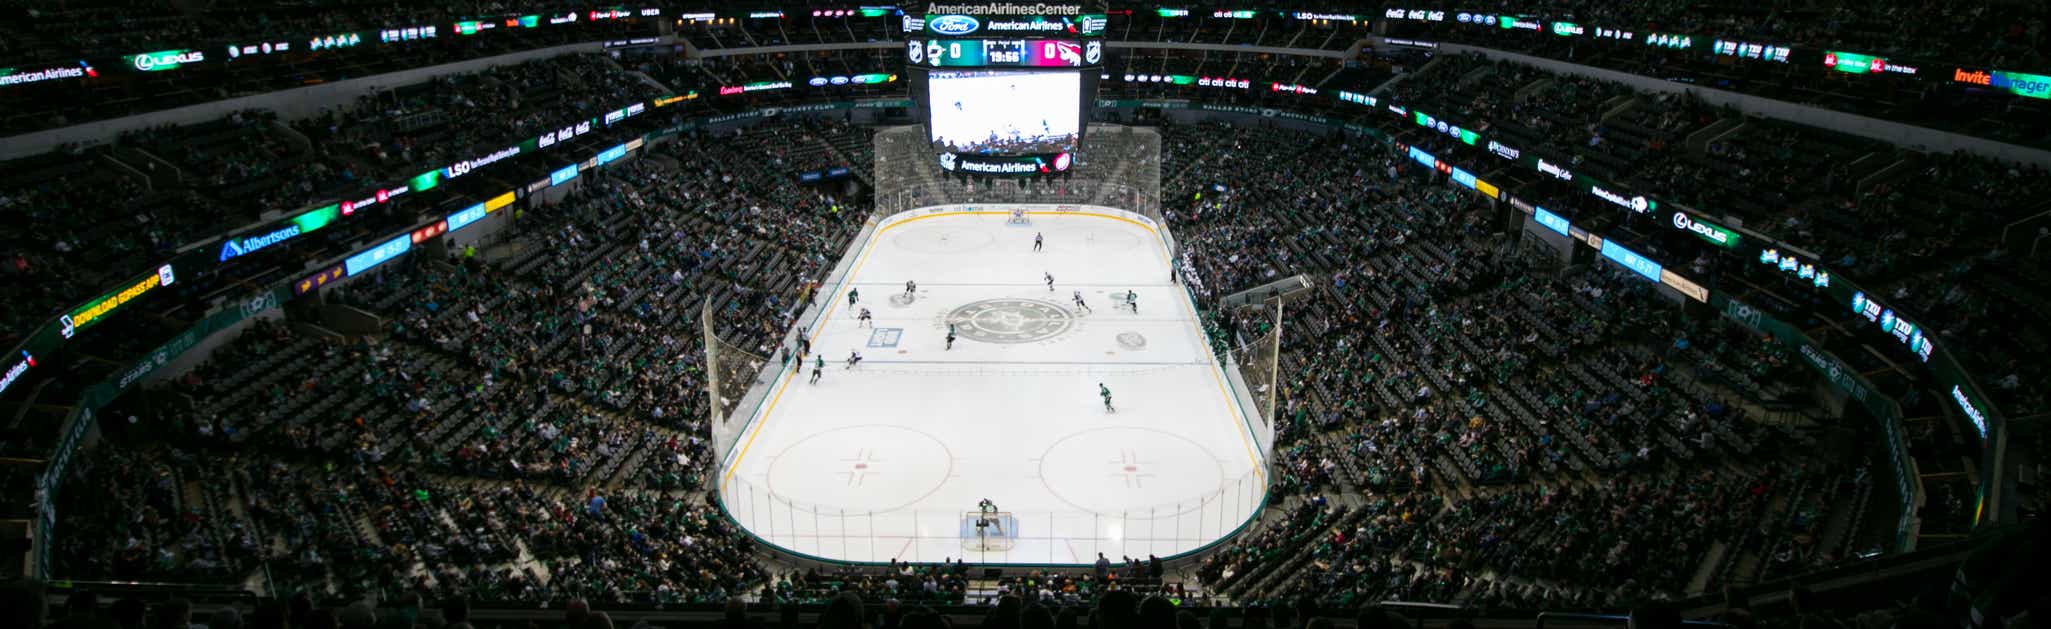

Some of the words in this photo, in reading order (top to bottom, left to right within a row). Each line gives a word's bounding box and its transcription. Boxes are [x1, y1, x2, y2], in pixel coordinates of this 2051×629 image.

[940, 20, 969, 31] Ford
[987, 20, 1030, 31] American
[1030, 20, 1063, 31] Airlines
[153, 52, 204, 65] LEXUS
[950, 43, 961, 59] 0
[1044, 43, 1056, 59] 0
[45, 67, 83, 80] Airlines
[447, 160, 470, 178] LSO
[961, 160, 1001, 172] American
[1001, 163, 1036, 173] Airlines
[242, 225, 300, 252] Albertsons
[1687, 219, 1728, 243] LEXUS
[74, 296, 118, 328] DOWNLOAD
[1895, 316, 1912, 336] TXU
